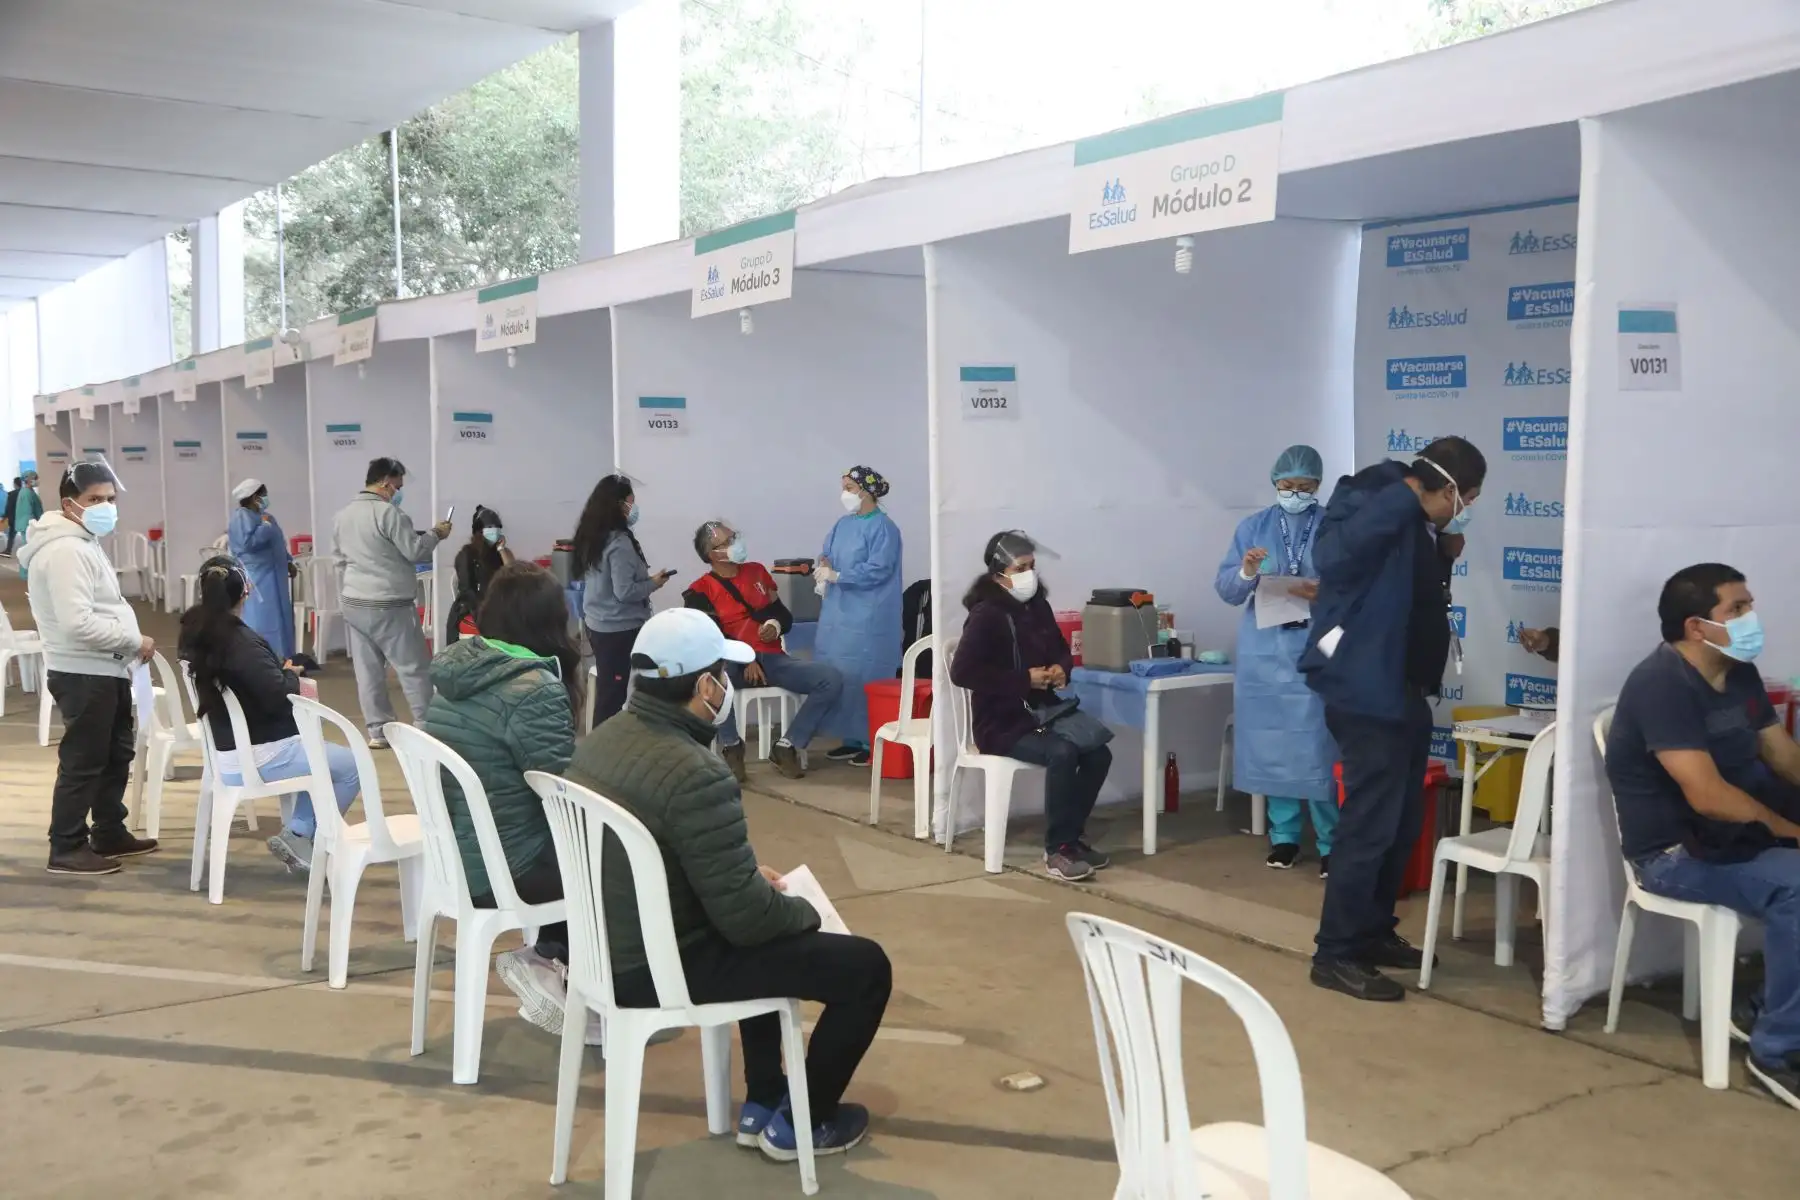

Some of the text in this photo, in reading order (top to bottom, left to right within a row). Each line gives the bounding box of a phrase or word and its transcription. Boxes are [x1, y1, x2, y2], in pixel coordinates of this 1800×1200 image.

[1170, 155, 1236, 182] Grupo D
[1152, 178, 1253, 219] Módulo 2
[1089, 204, 1137, 229] EsSalud
[1389, 233, 1467, 250] #Vacunarse
[740, 250, 773, 270] Grupo D
[1403, 246, 1454, 263] EsSalud
[731, 267, 780, 294] Módulo 3
[700, 283, 725, 301] EsSalud
[1416, 307, 1468, 327] EsSalud
[500, 319, 530, 337] Módulo 4
[1390, 360, 1464, 374] #Vacunarse
[1402, 373, 1452, 387] EsSalud
[1519, 434, 1568, 448] EsSalu
